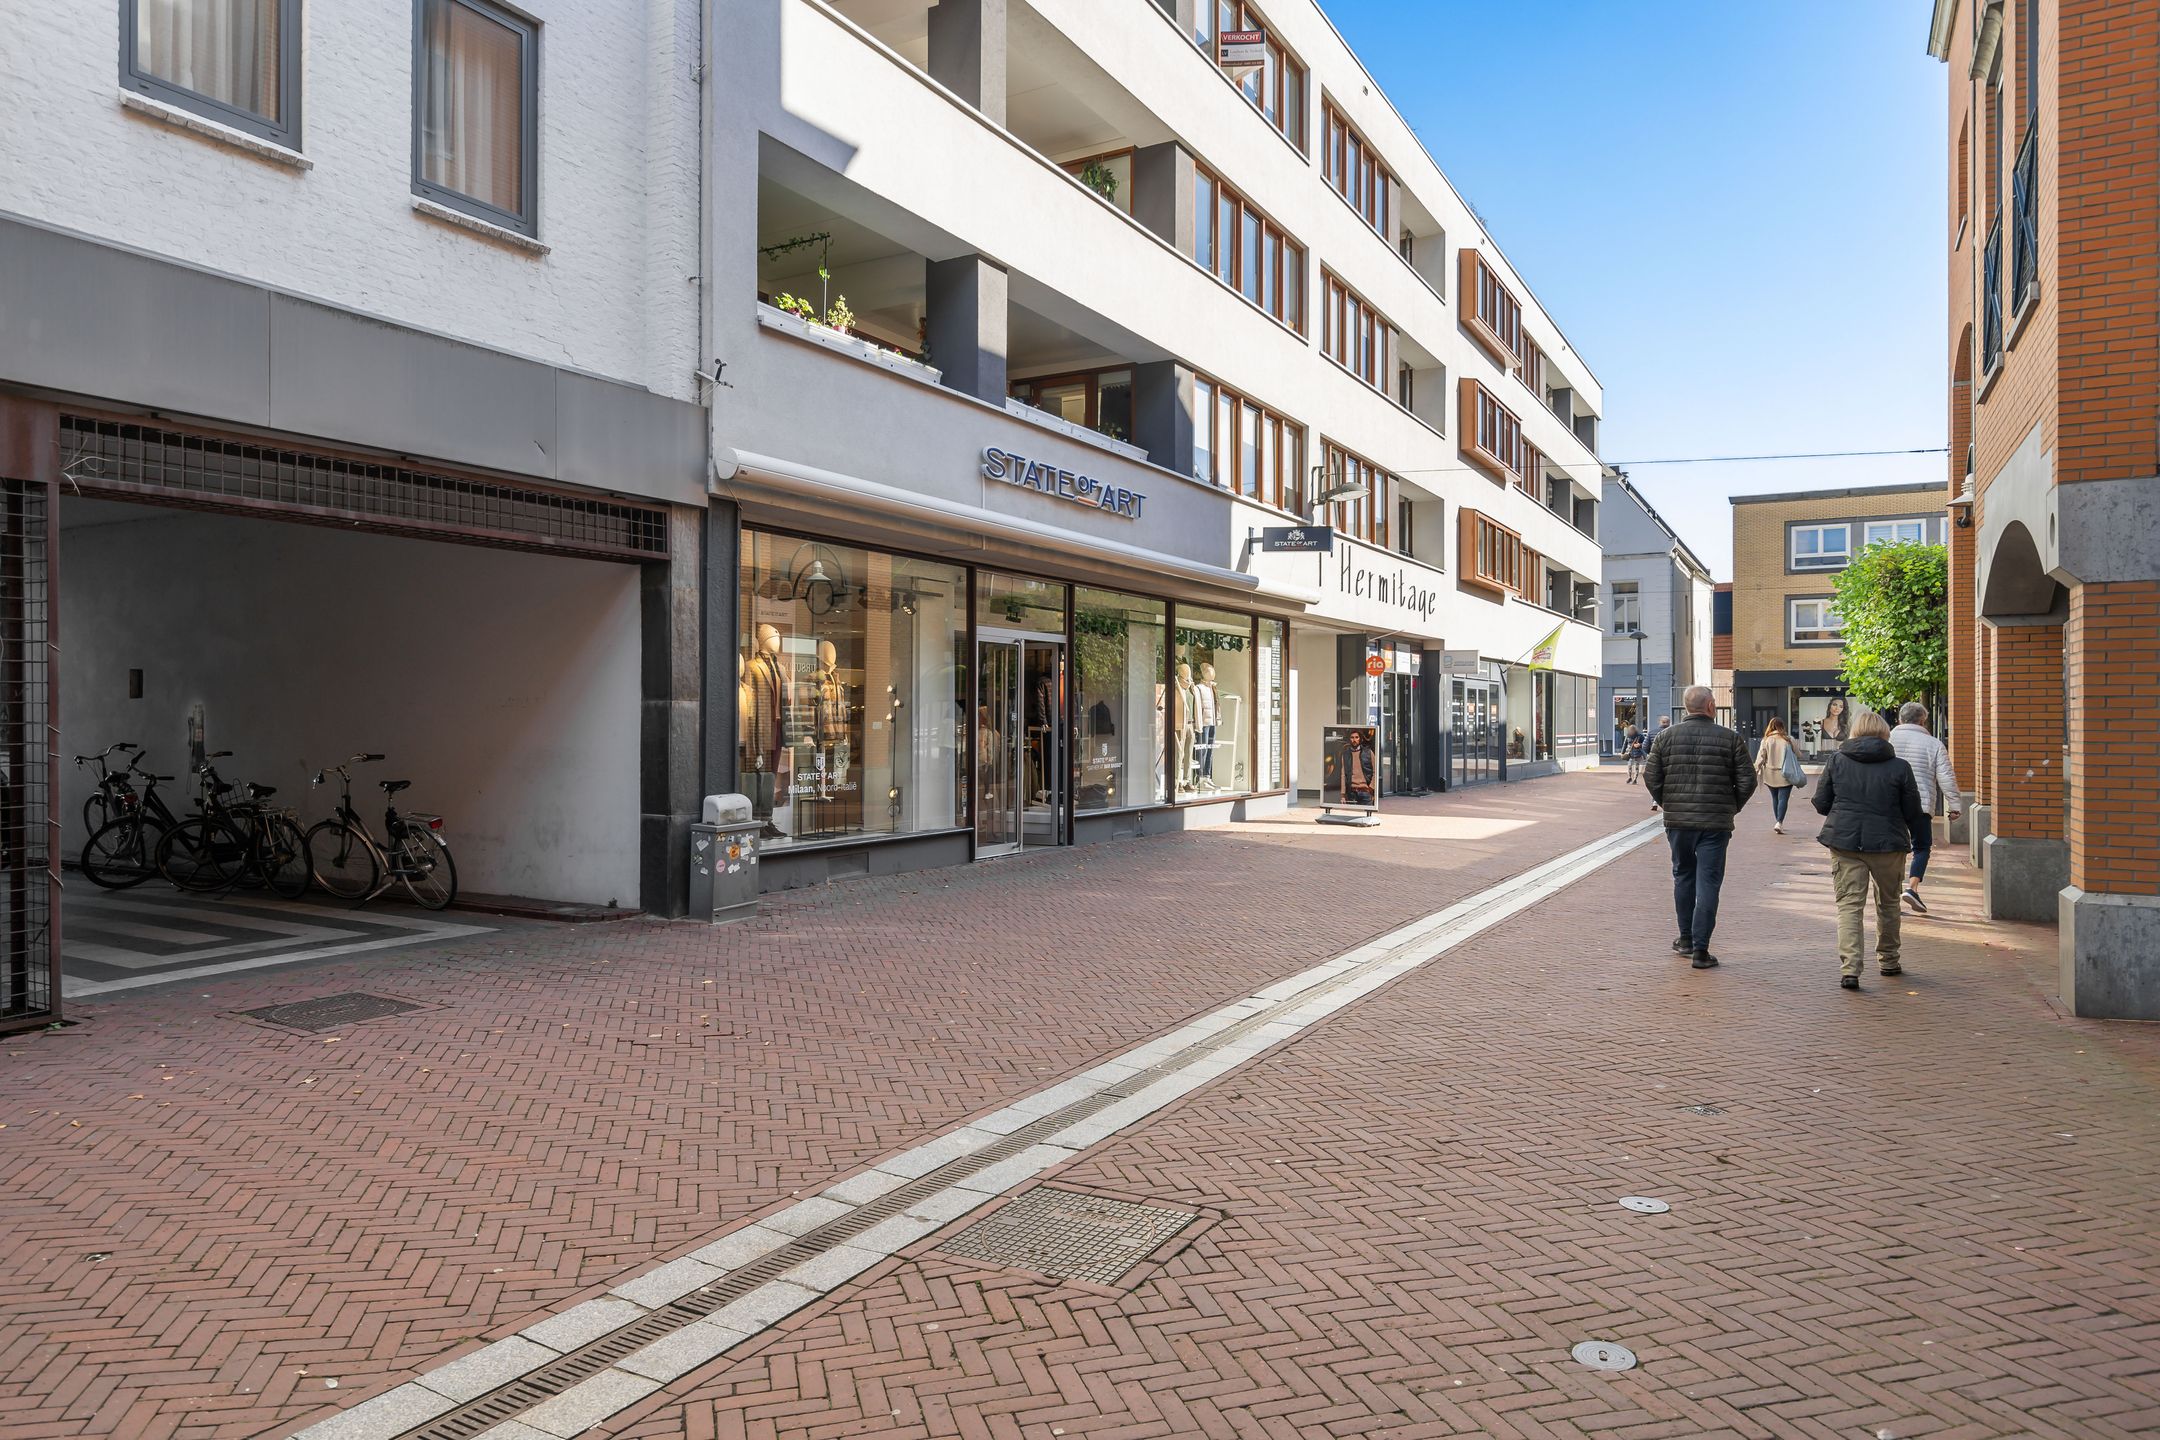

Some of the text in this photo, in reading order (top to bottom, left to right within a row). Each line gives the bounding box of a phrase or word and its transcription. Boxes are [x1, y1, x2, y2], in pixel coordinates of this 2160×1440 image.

[982, 445, 1147, 519] STATE OF ART
[1367, 658, 1384, 670] ria
[797, 772, 820, 781] STATE
[788, 784, 816, 794] Milaan,
